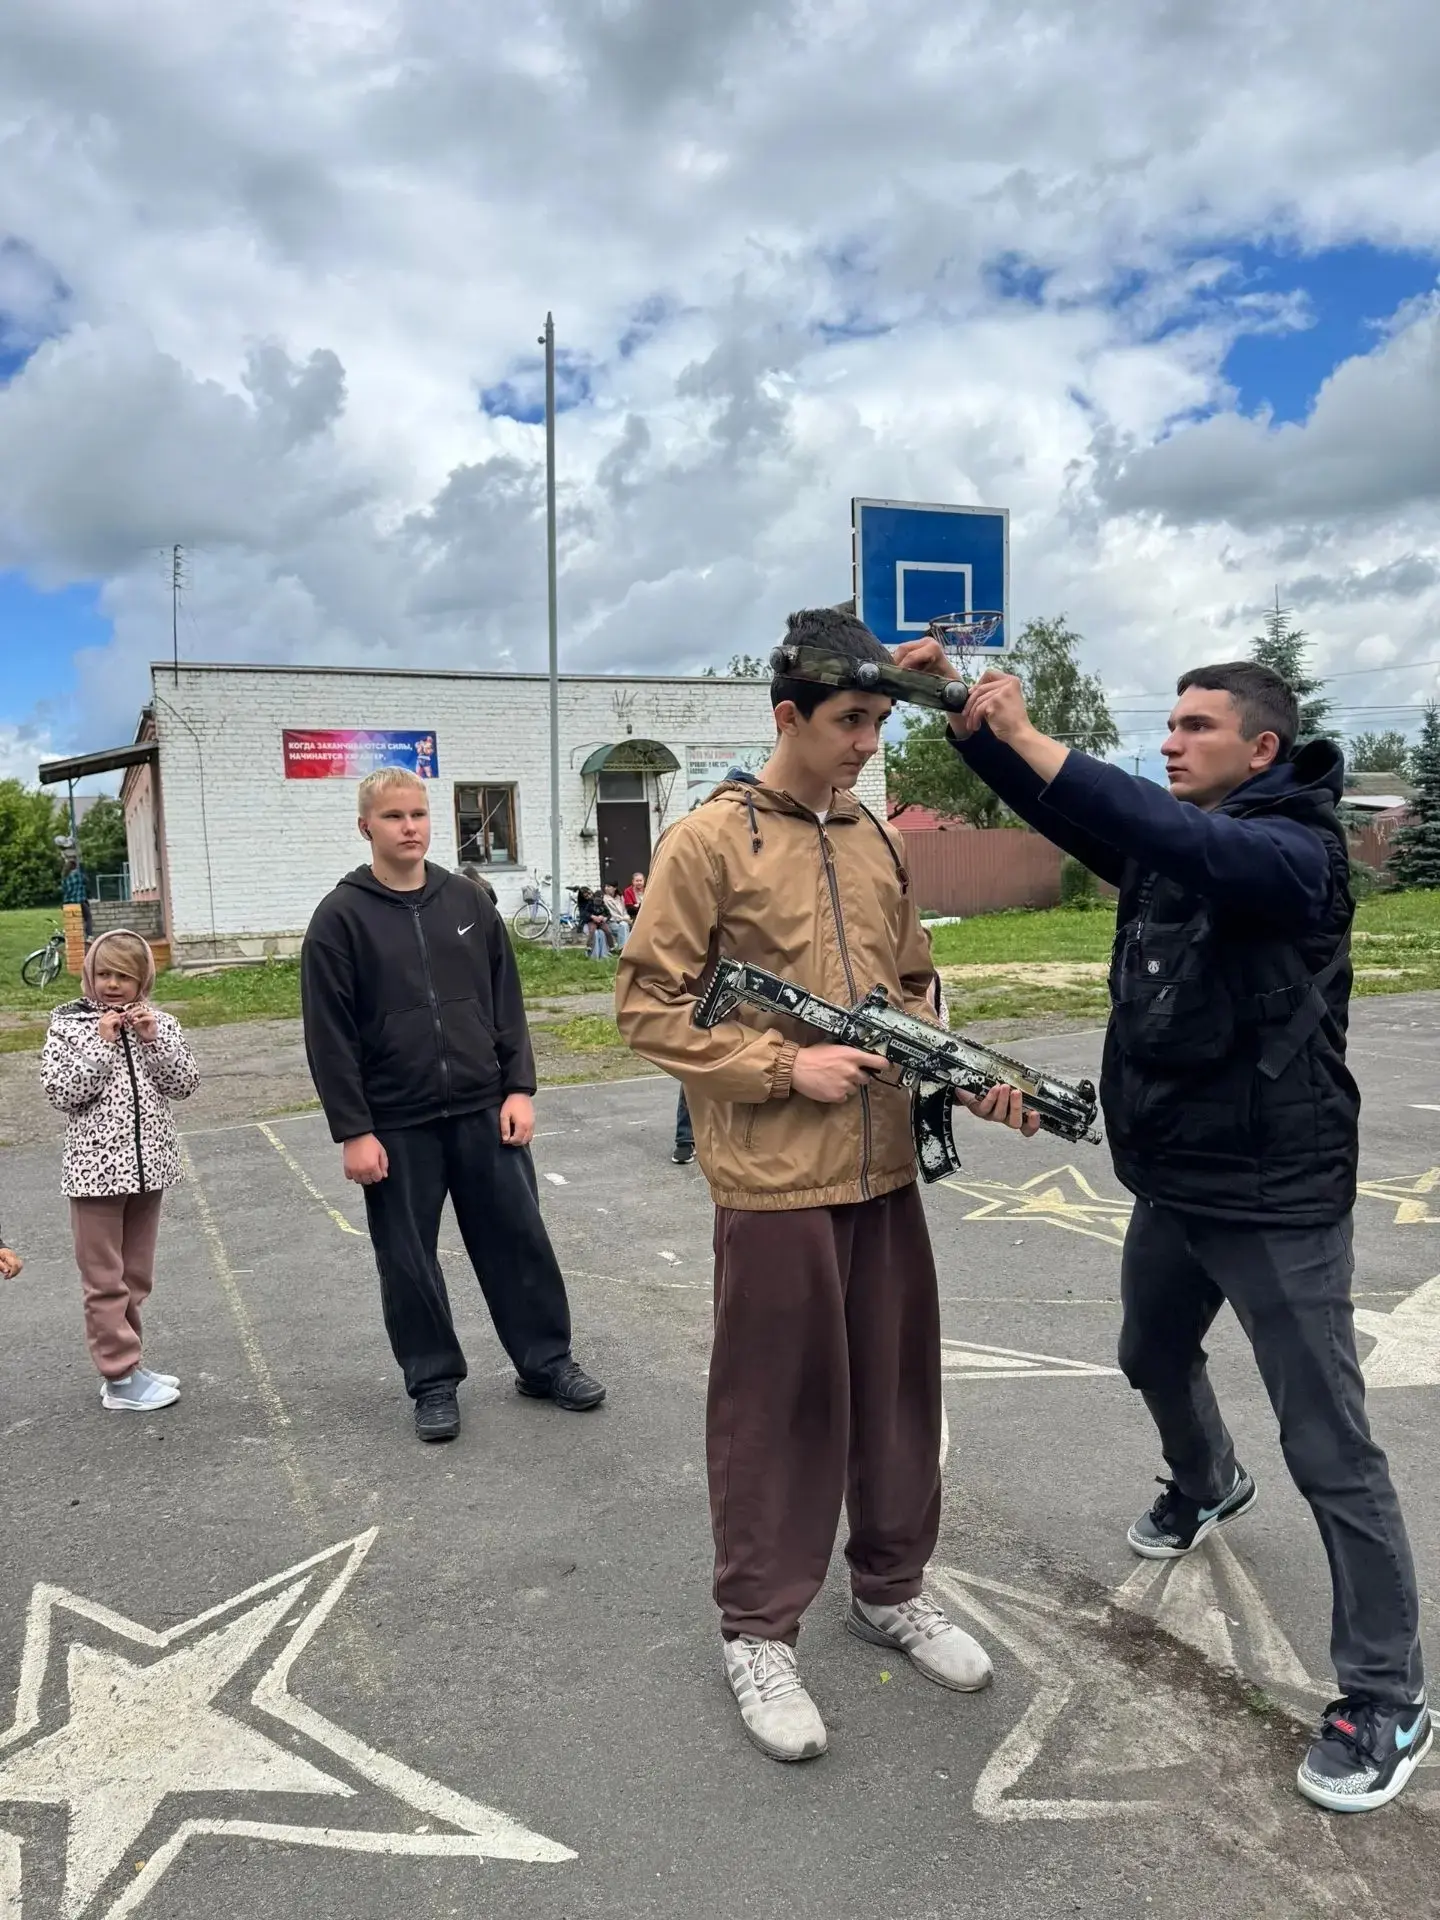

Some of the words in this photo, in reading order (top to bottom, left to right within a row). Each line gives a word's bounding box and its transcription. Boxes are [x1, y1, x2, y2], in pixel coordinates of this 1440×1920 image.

[288, 742, 316, 751] КОГДА
[387, 743, 413, 752] СИЛЫ,
[289, 752, 344, 761] НАЧИНАЕТСЯ
